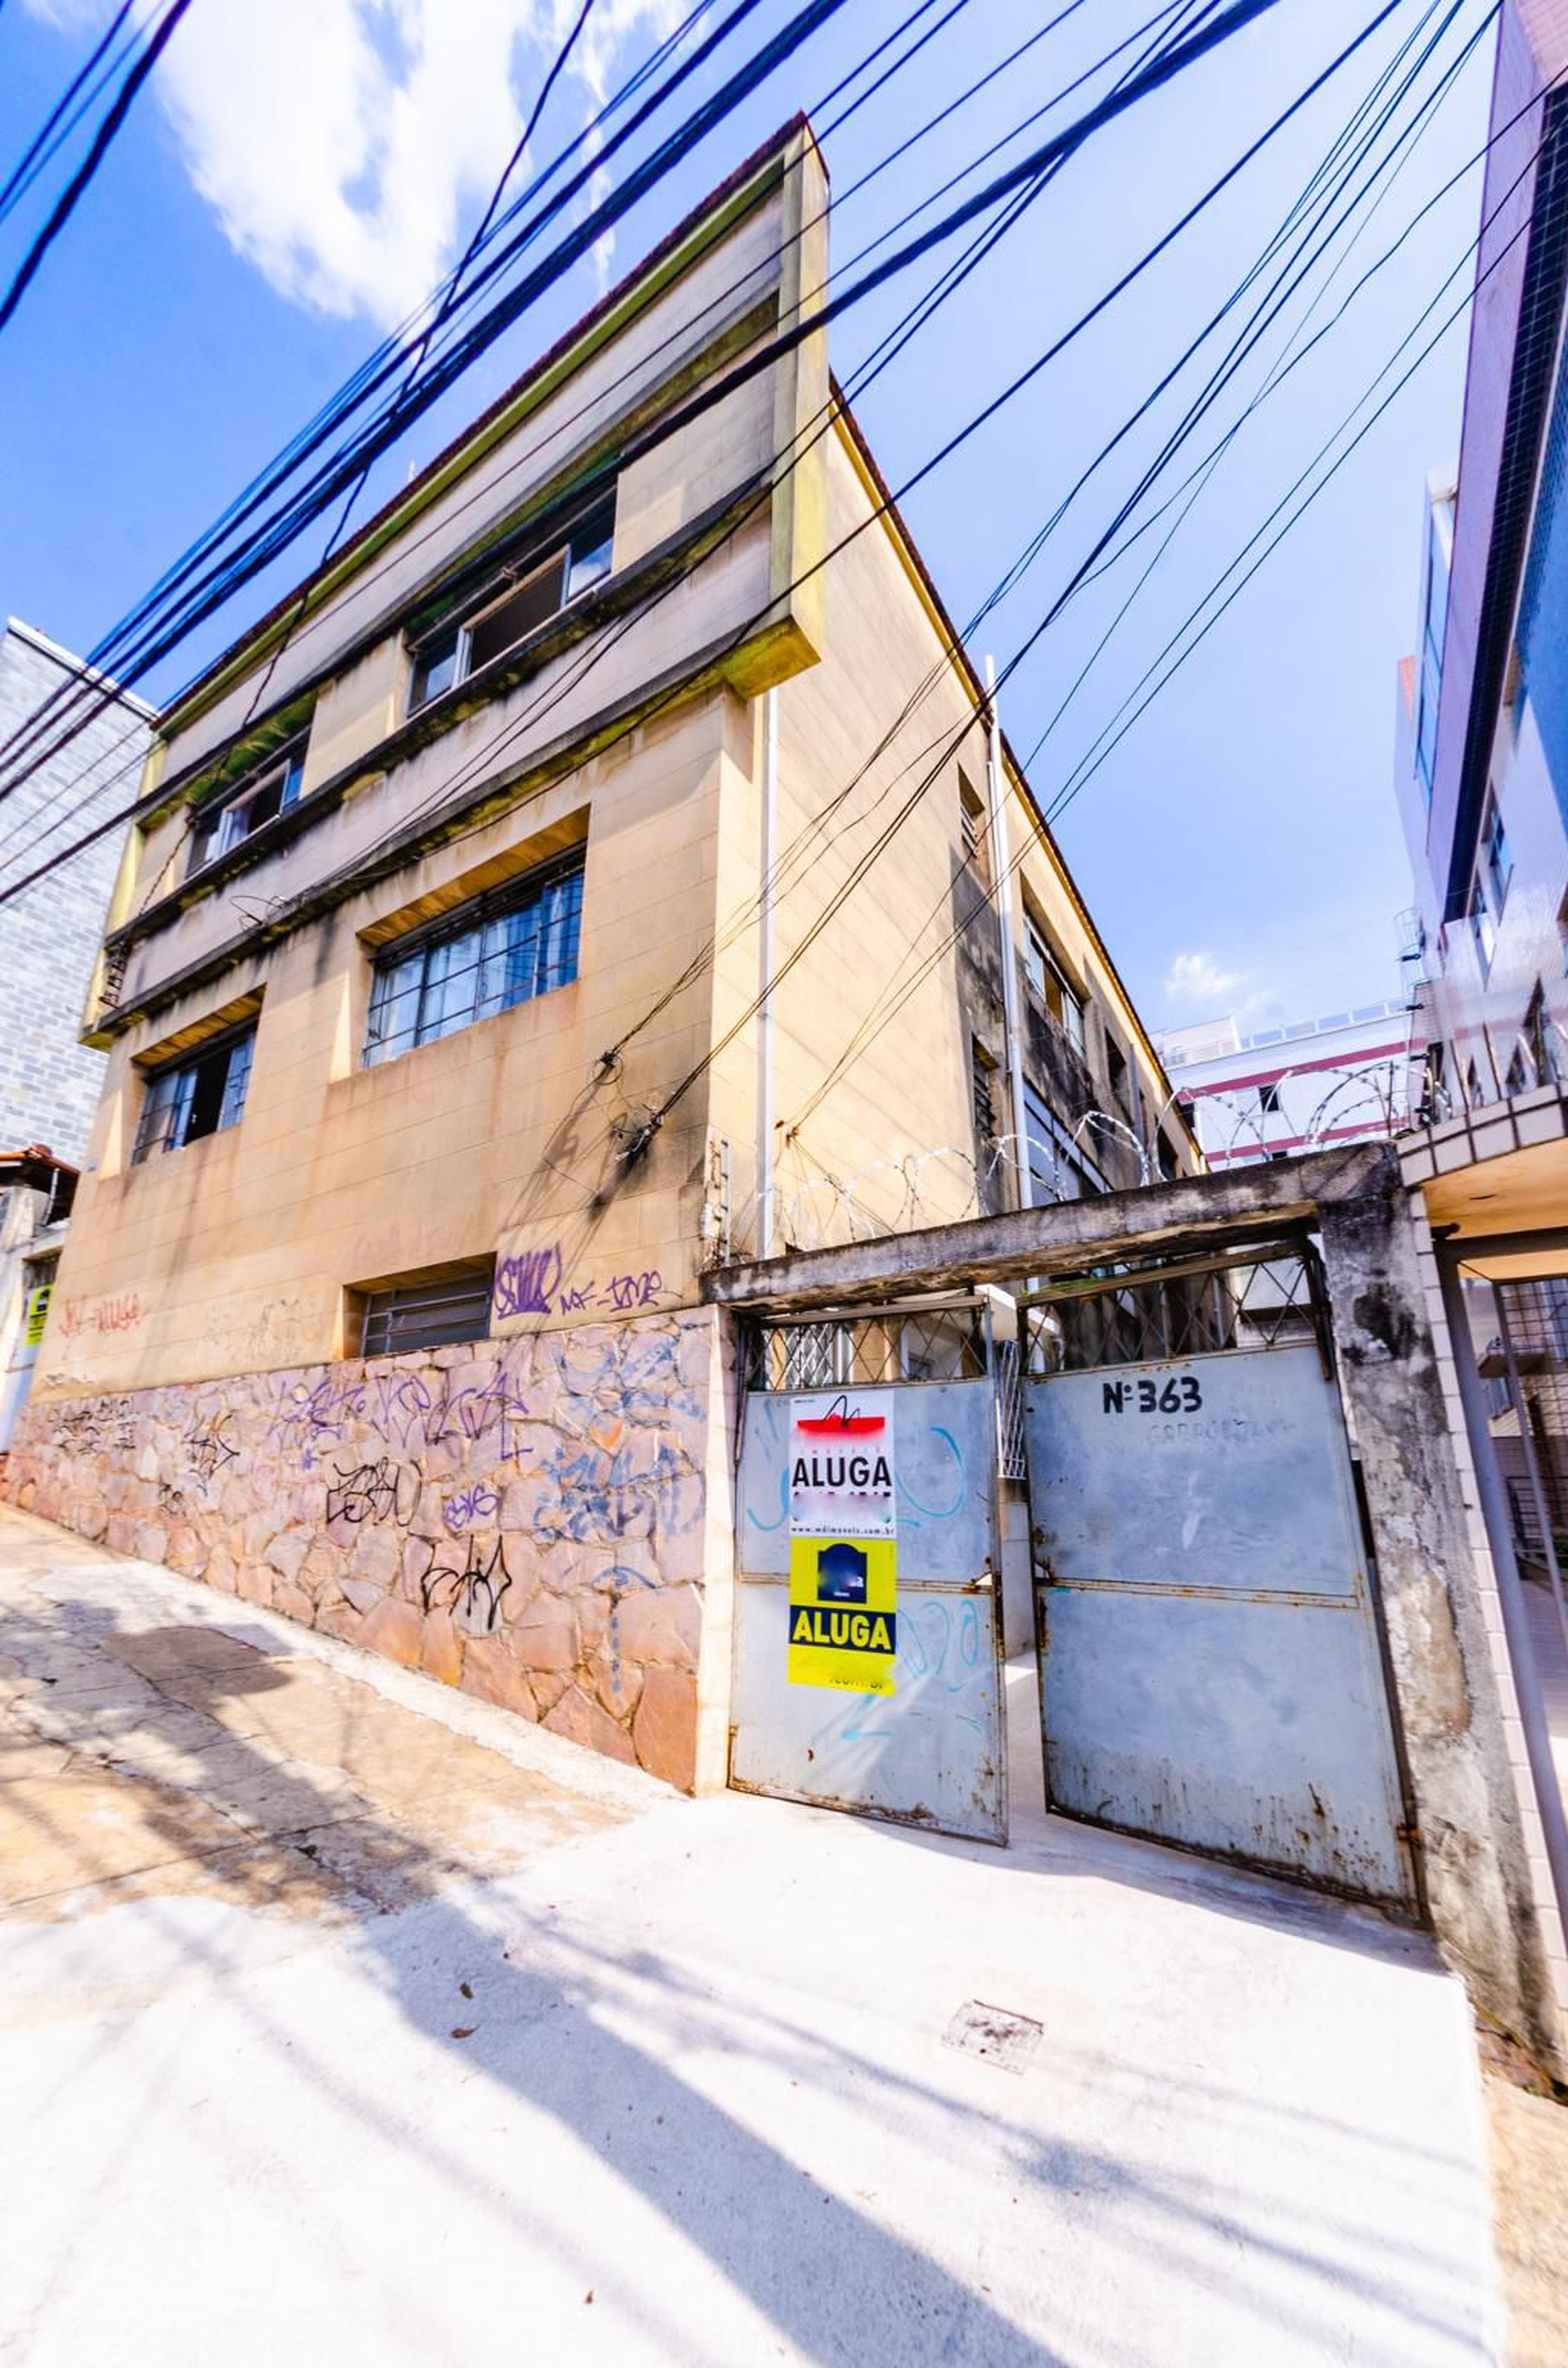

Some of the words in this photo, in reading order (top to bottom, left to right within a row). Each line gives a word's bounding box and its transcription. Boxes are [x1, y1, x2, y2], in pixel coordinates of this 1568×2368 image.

[1138, 1376, 1203, 1414] 363
[792, 1456, 892, 1487] ALUGA
[793, 1610, 891, 1650] ALUGA
